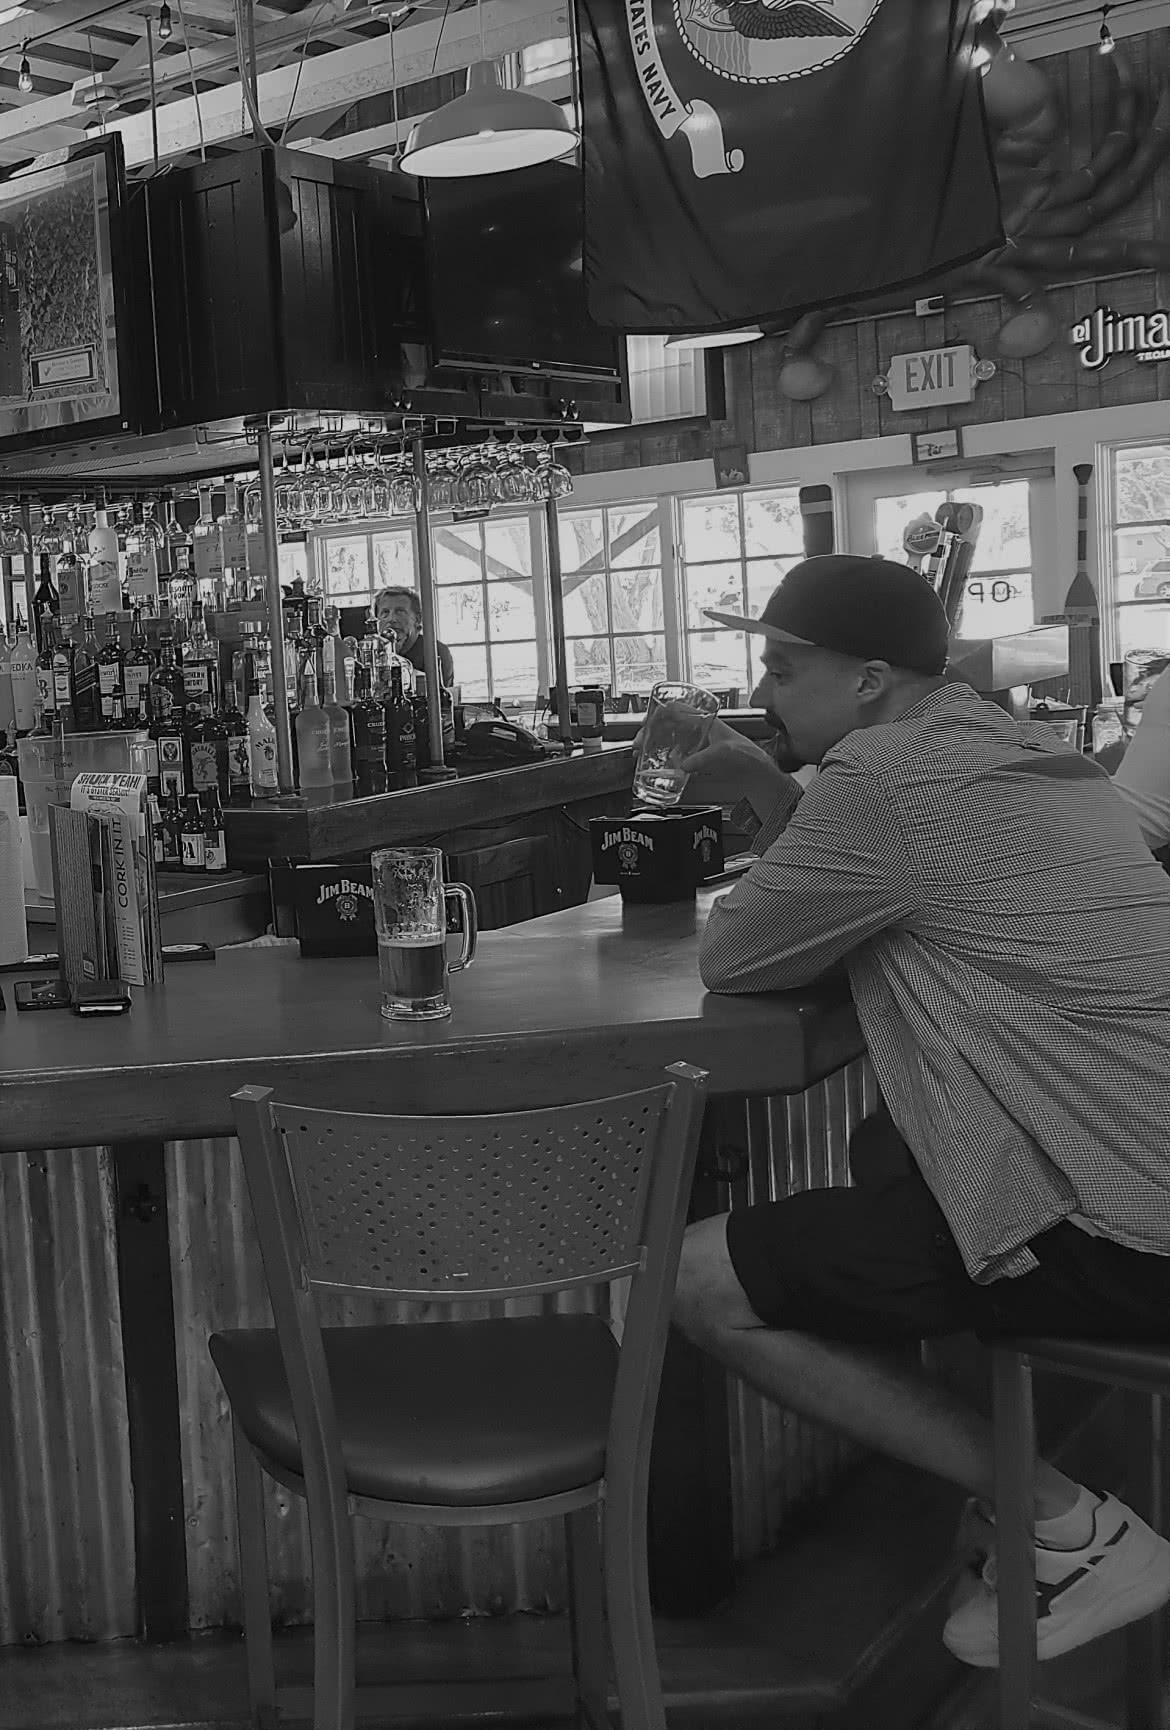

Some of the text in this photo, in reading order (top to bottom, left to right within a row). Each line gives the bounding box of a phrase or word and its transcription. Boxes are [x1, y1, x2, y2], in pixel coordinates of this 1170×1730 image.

[642, 62, 677, 120] NAVY
[905, 352, 957, 392] EXIT
[112, 816, 123, 834] IT
[113, 838, 125, 855] IN
[602, 827, 654, 852] JIM BEAM
[116, 860, 129, 909] CORK
[316, 879, 375, 905] JIM BEAM
